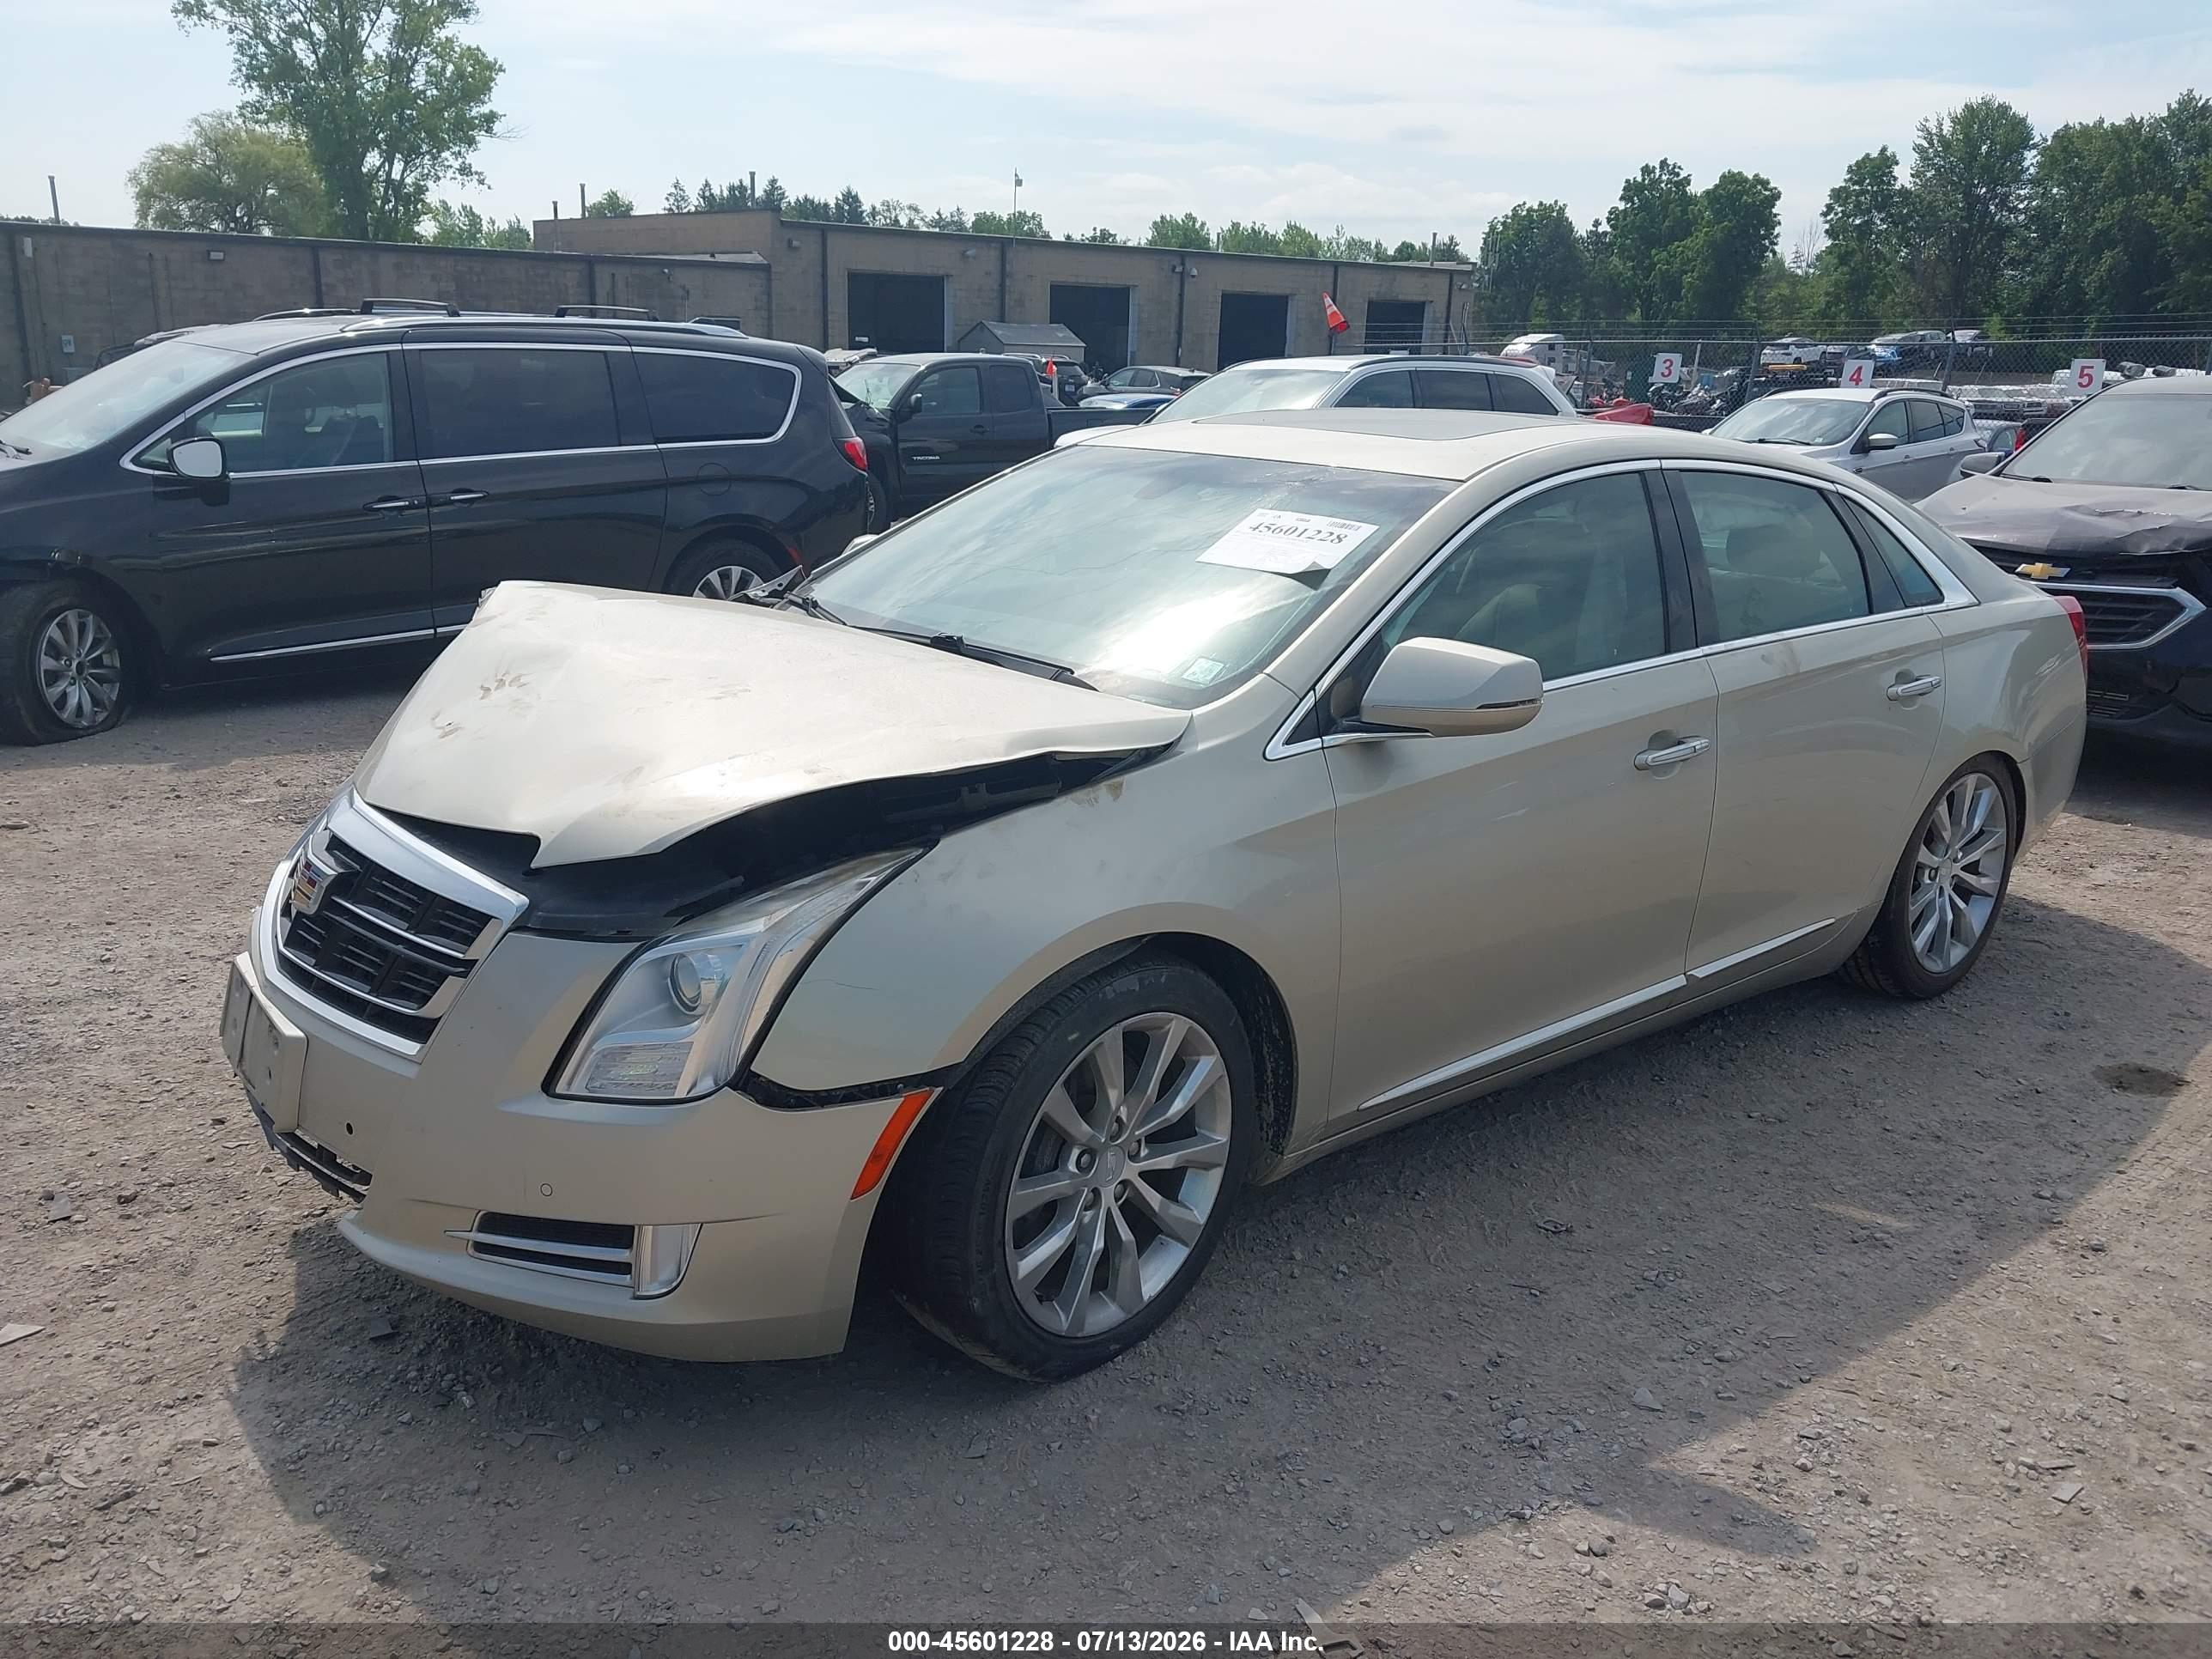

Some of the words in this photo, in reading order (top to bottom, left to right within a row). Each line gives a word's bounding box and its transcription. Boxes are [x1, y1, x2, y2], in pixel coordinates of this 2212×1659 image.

[1661, 358, 1674, 378] 3
[1849, 365, 1863, 386] 4
[2077, 365, 2094, 388] 5
[1249, 521, 1349, 544] 45601228
